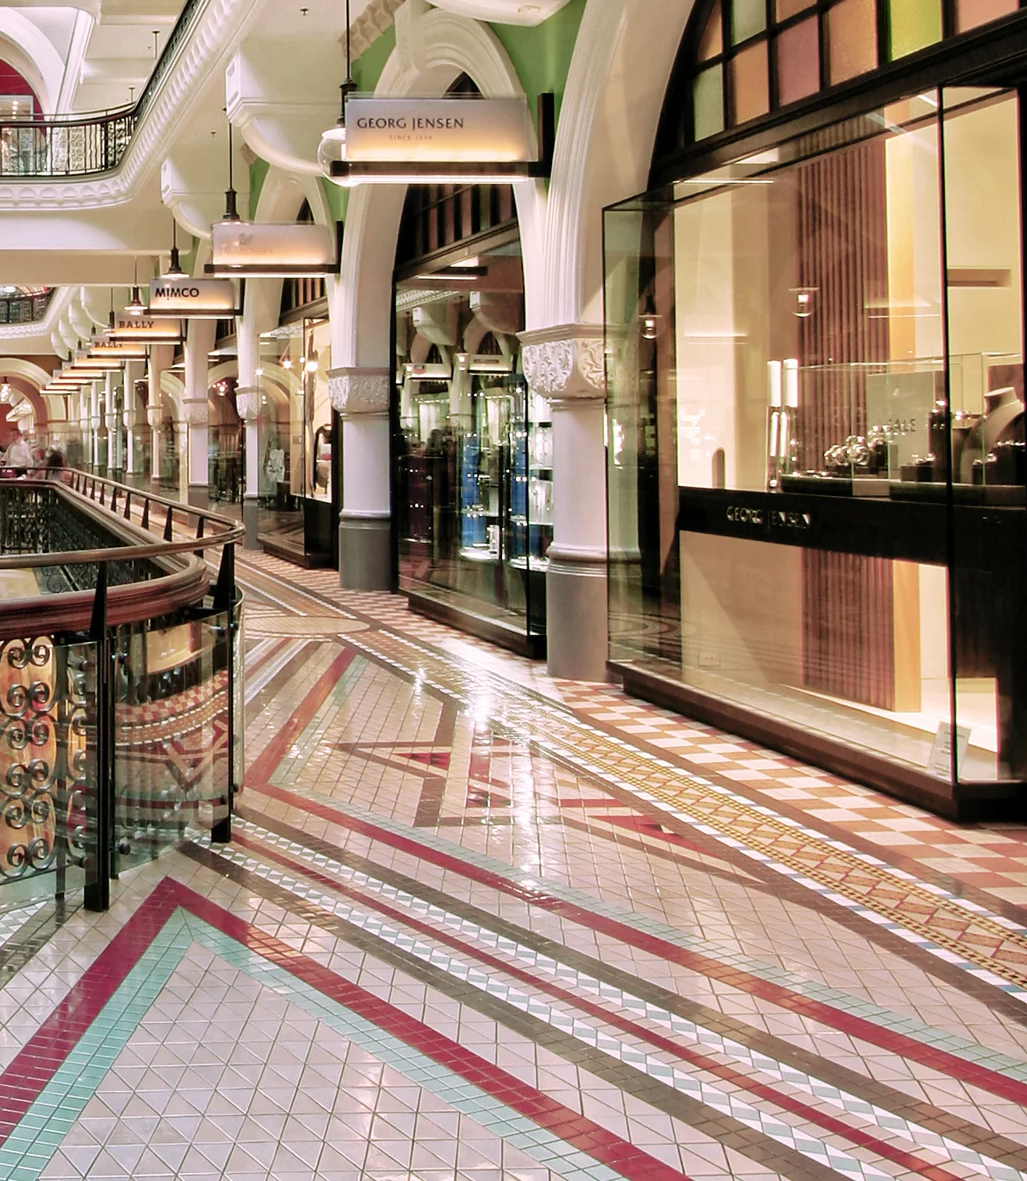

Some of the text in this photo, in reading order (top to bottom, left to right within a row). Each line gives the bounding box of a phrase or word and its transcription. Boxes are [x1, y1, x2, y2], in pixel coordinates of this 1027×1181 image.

[356, 117, 464, 131] GEORG JENSEN
[118, 320, 155, 329] BALLY
[725, 506, 763, 524] GEORG
